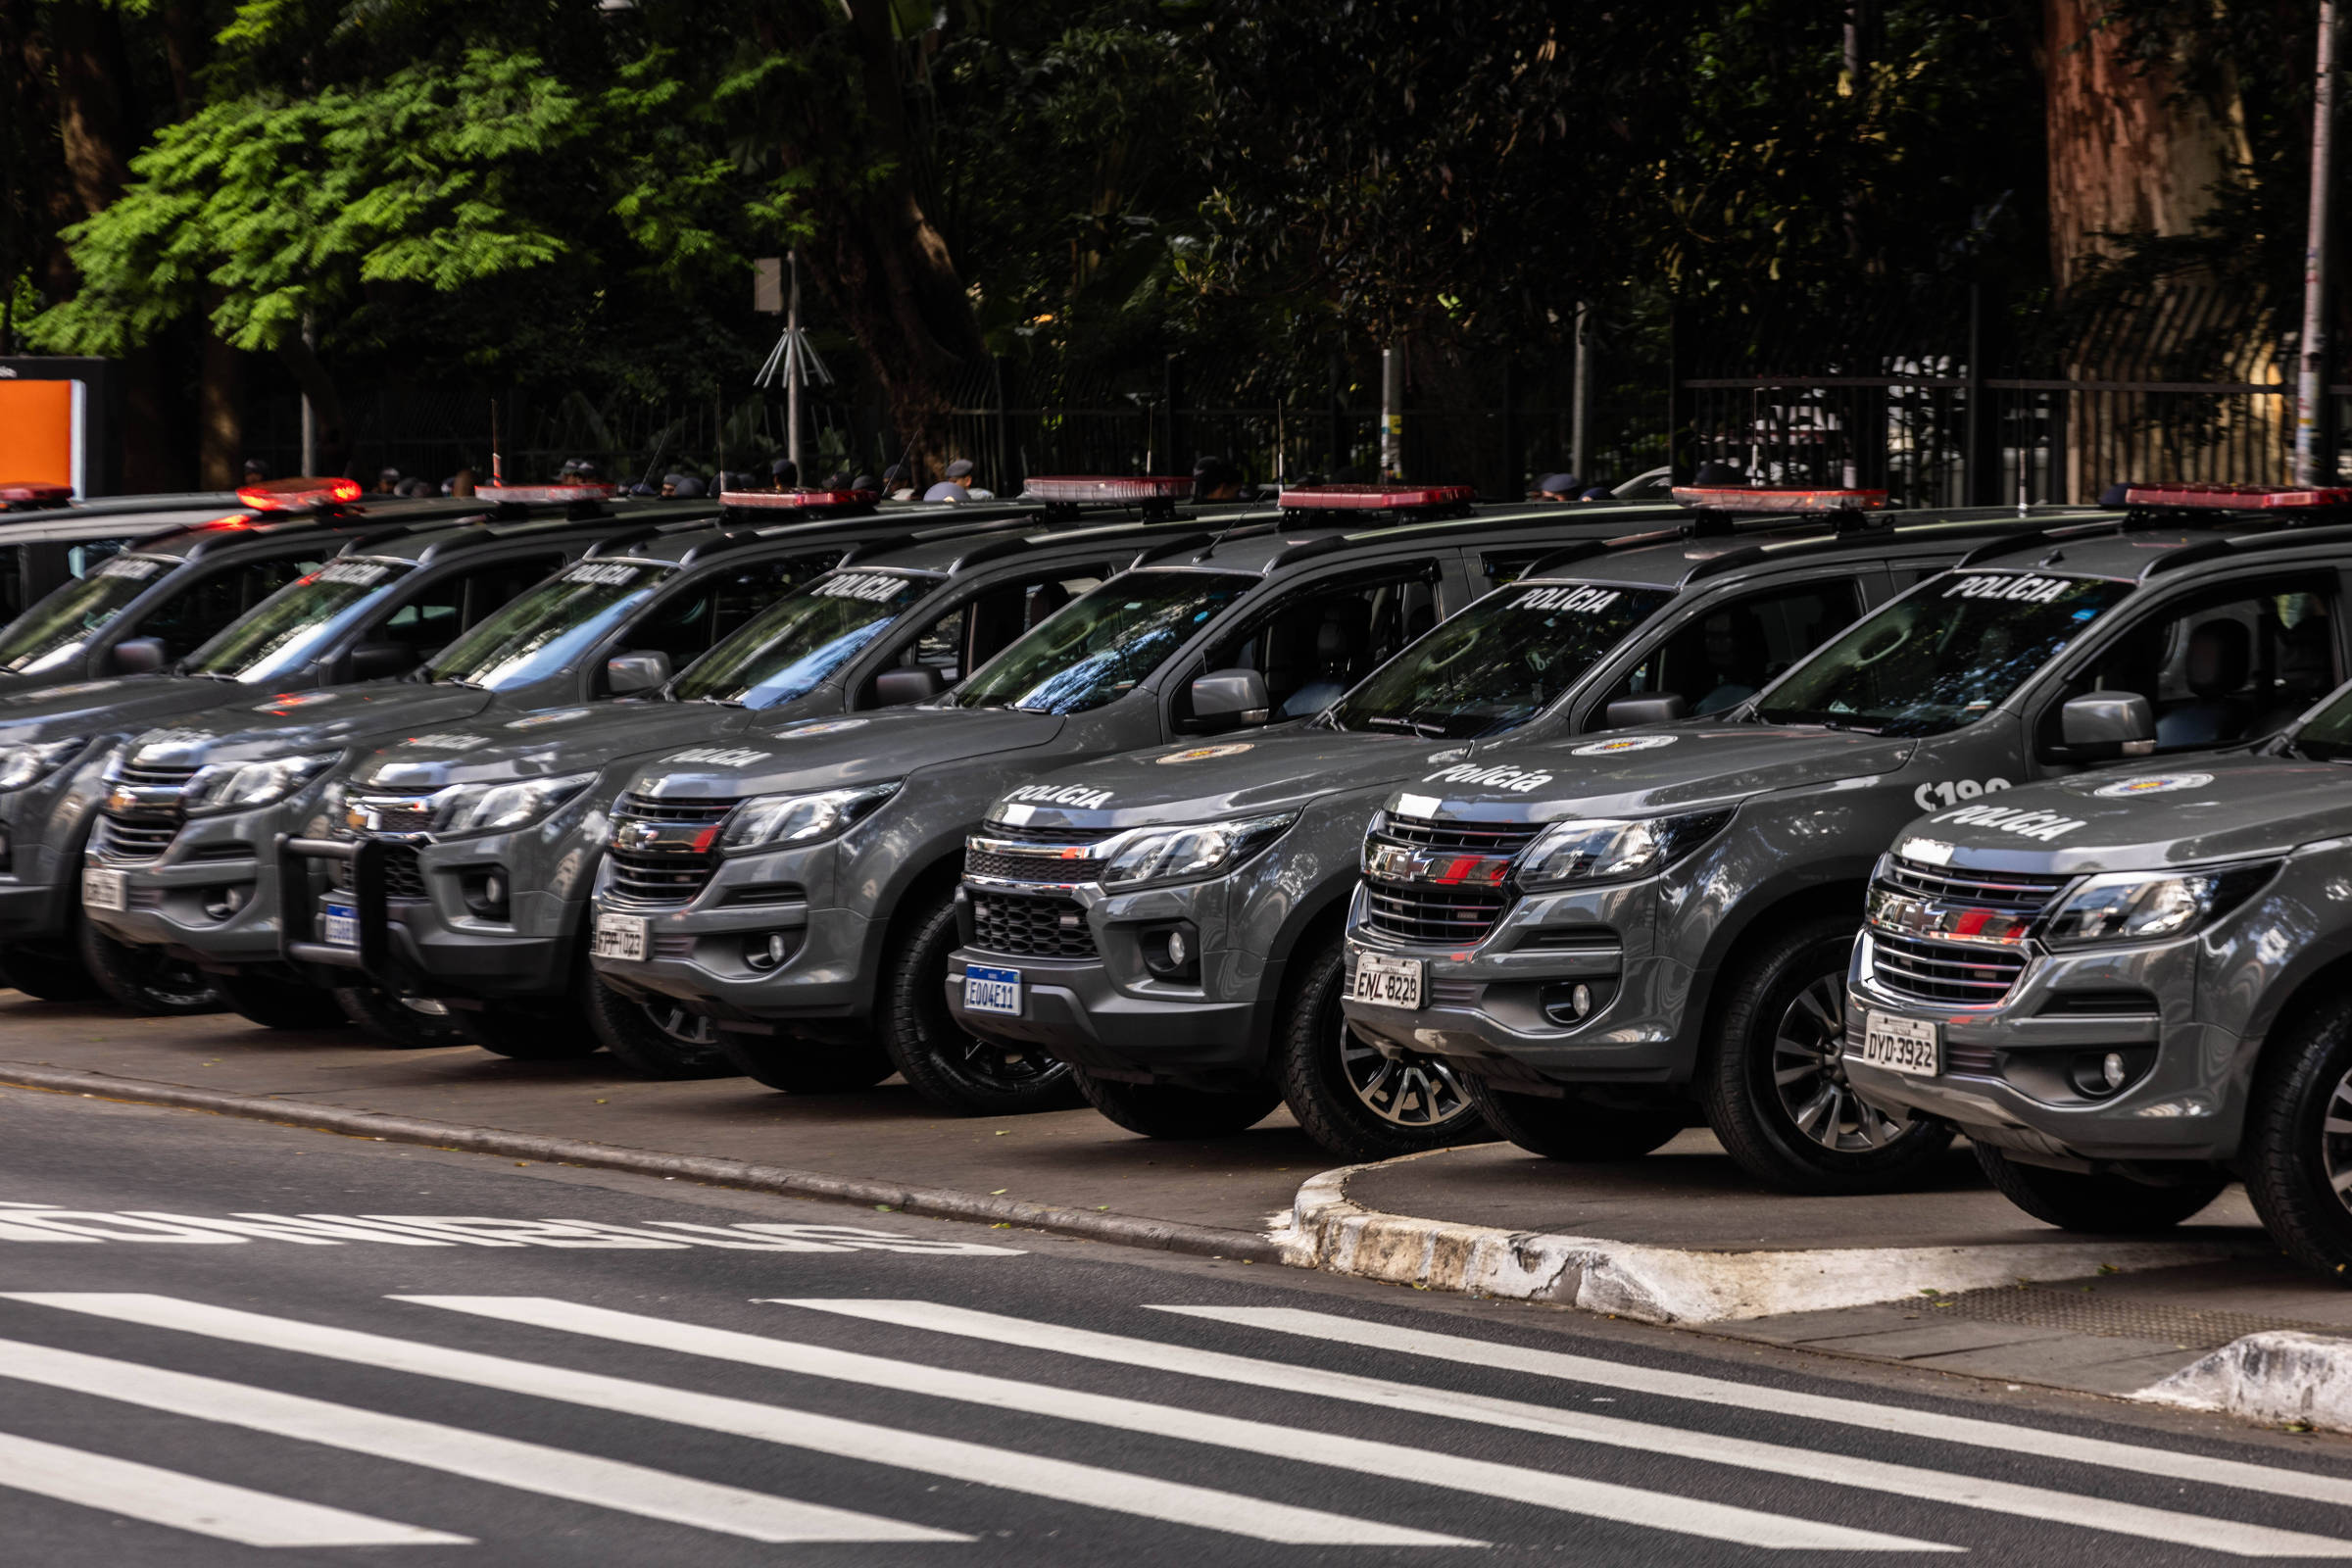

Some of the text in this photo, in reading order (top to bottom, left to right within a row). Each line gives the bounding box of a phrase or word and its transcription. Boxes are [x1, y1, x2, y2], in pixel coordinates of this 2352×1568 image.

[809, 571, 909, 603] POLÍCIA
[1505, 584, 1622, 613] POLÍCIA
[1941, 572, 2072, 604] POLÍCIA
[657, 746, 773, 768] POLÍCIA
[1002, 783, 1114, 810] POLÍCIA
[1930, 805, 2088, 842] POLÍCIA
